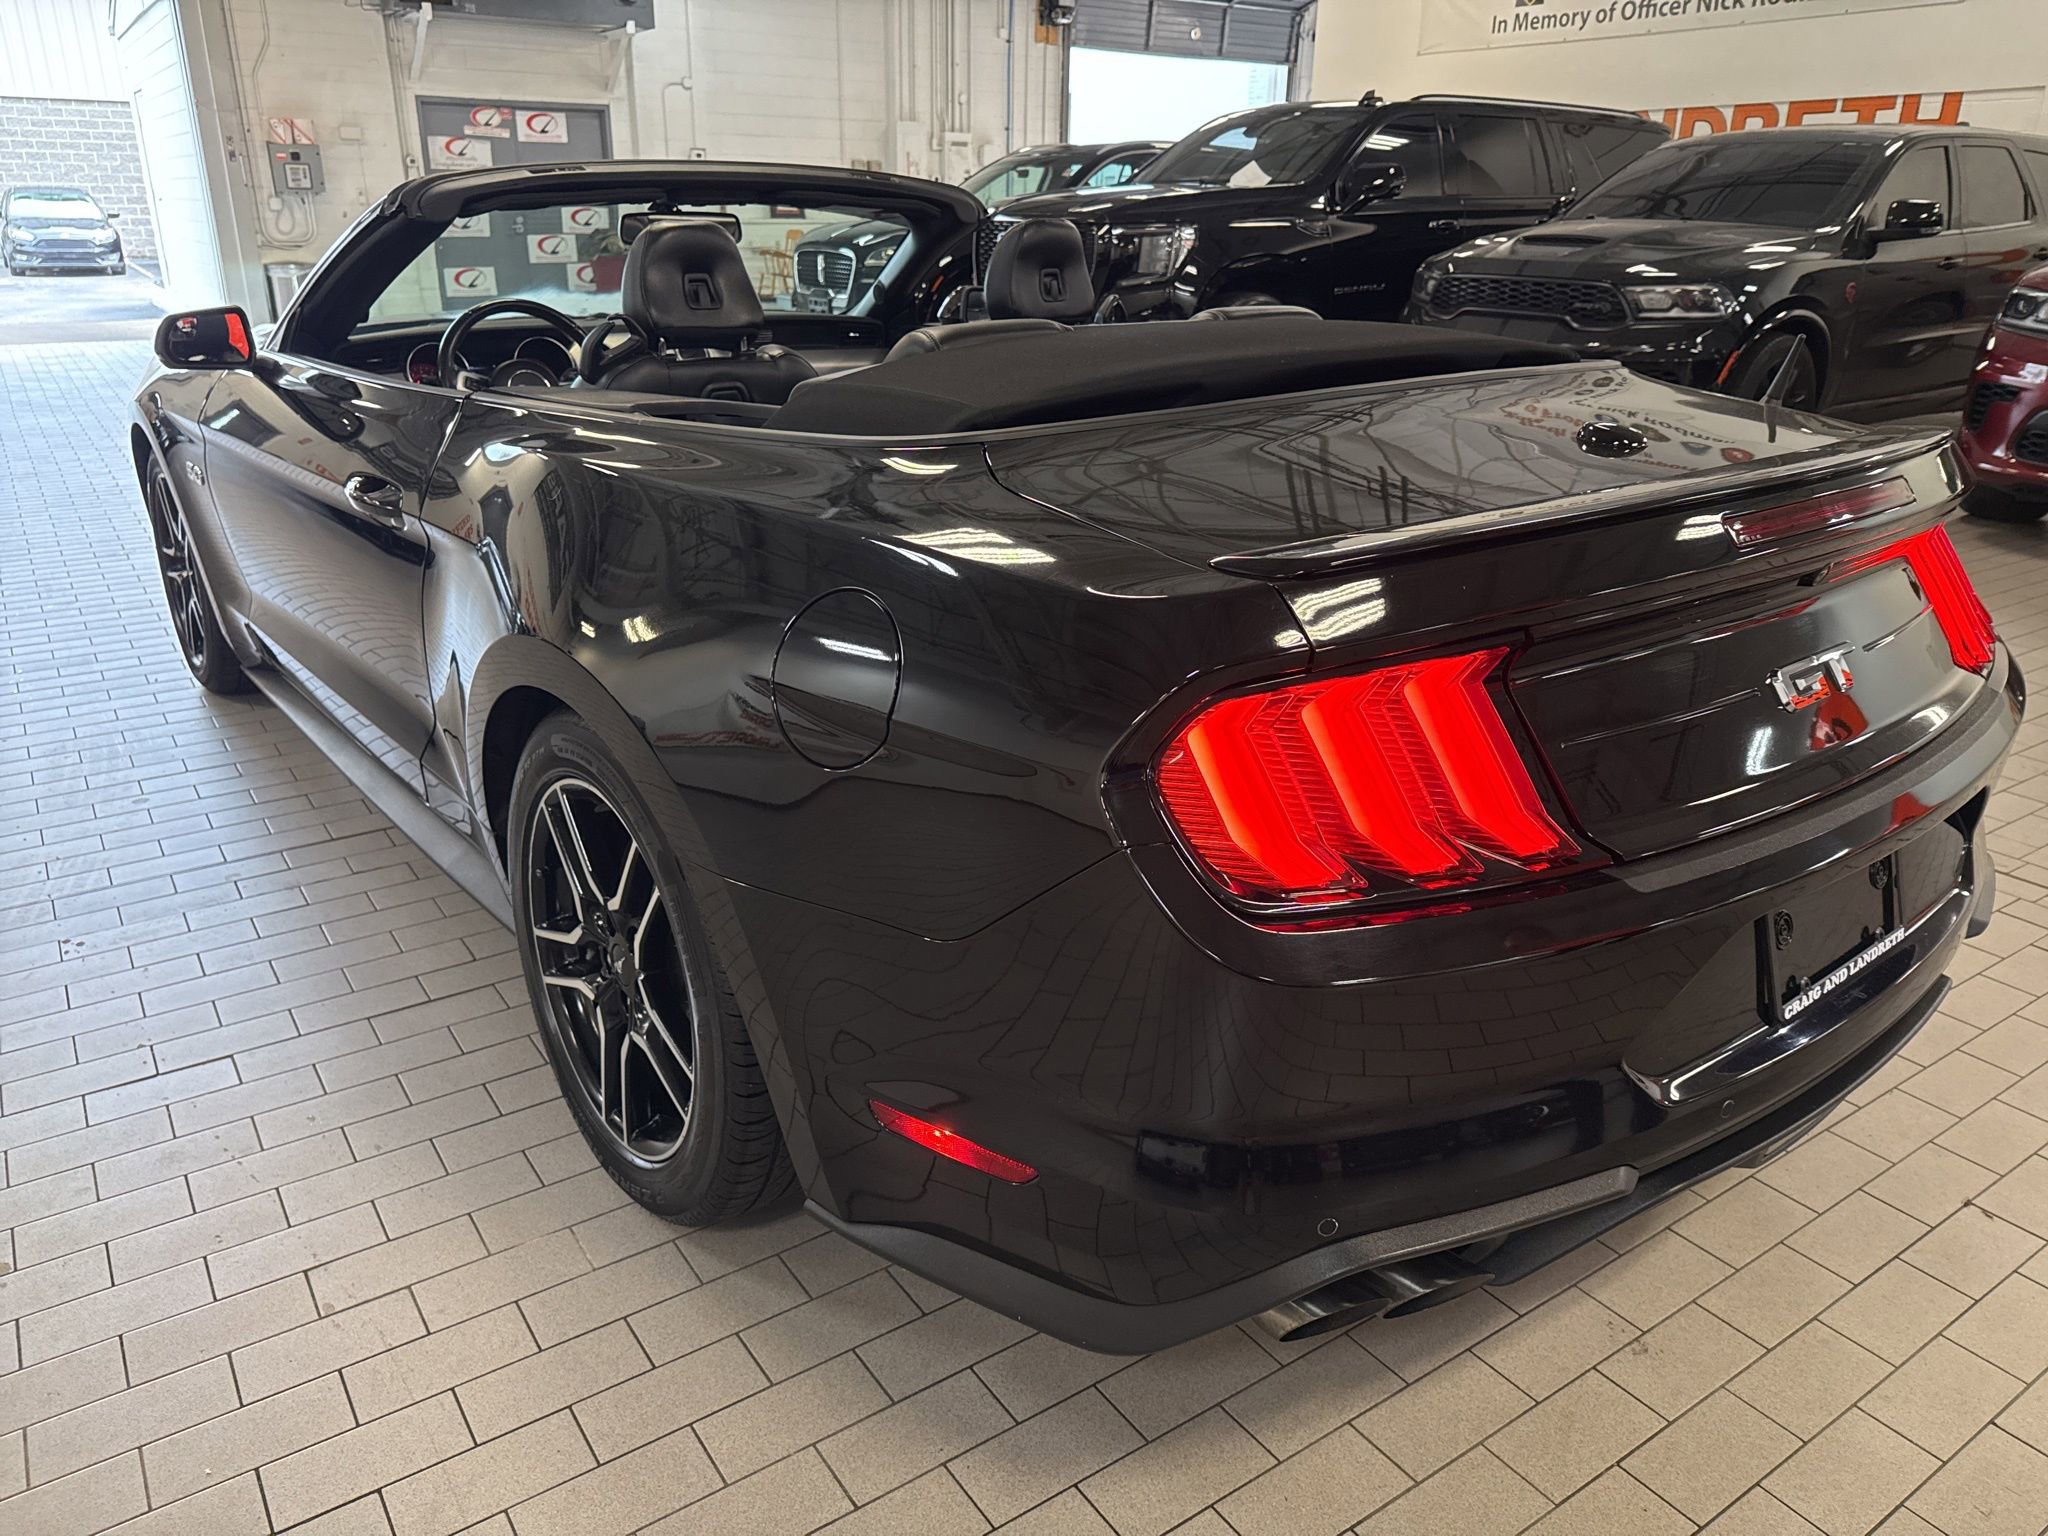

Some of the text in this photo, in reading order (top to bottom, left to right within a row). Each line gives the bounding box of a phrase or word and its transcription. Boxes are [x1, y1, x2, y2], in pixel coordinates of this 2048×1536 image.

[1491, 16, 1508, 34] In
[1512, 10, 1592, 31] Memory
[1595, 4, 1617, 24] of
[1621, 0, 1691, 21] Officer
[1767, 641, 1856, 713] GT
[1783, 927, 1905, 1020] CRAIG AND LANDRETH
